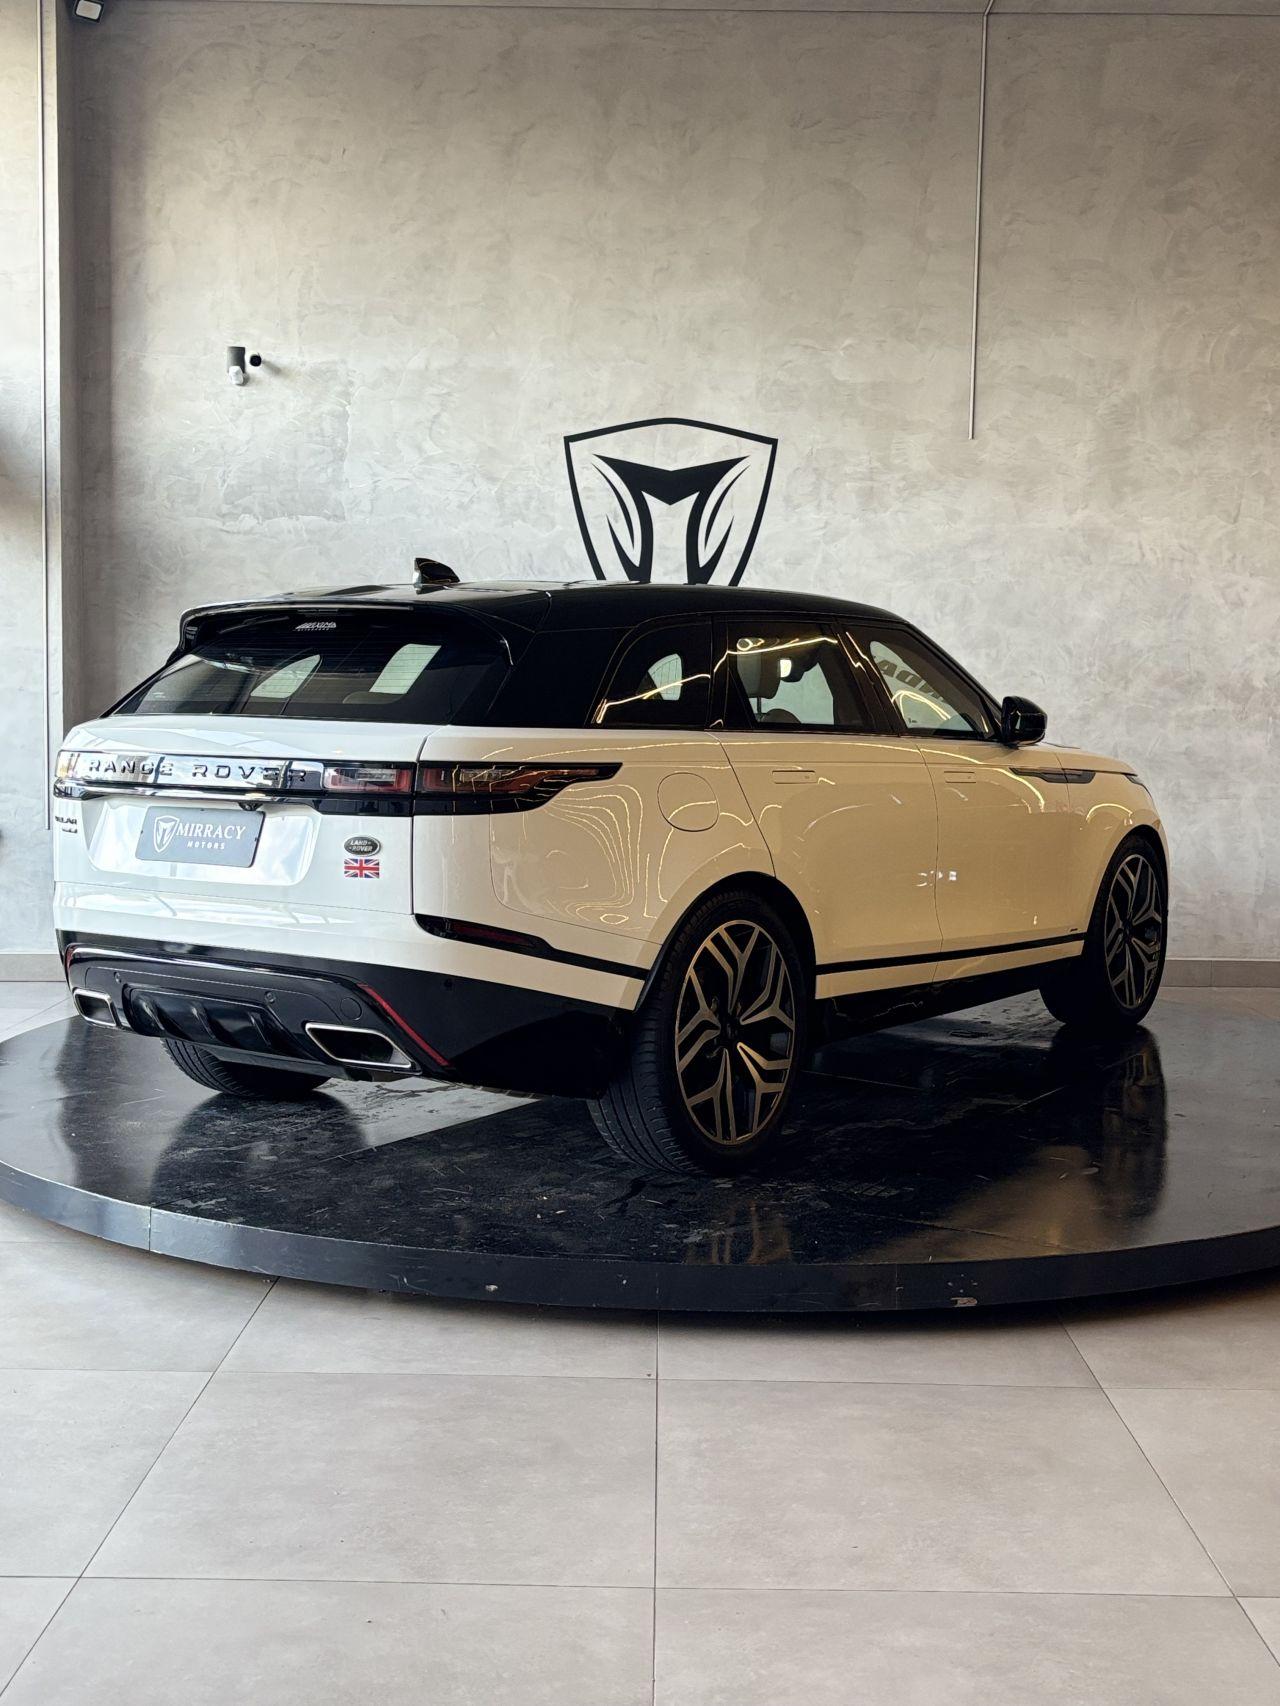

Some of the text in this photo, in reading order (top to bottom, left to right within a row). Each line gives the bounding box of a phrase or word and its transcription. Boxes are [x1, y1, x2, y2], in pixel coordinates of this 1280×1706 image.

[88, 759, 307, 782] RANGE ROVER
[176, 822, 246, 840] MIRRACY
[187, 841, 225, 850] MOTORS
